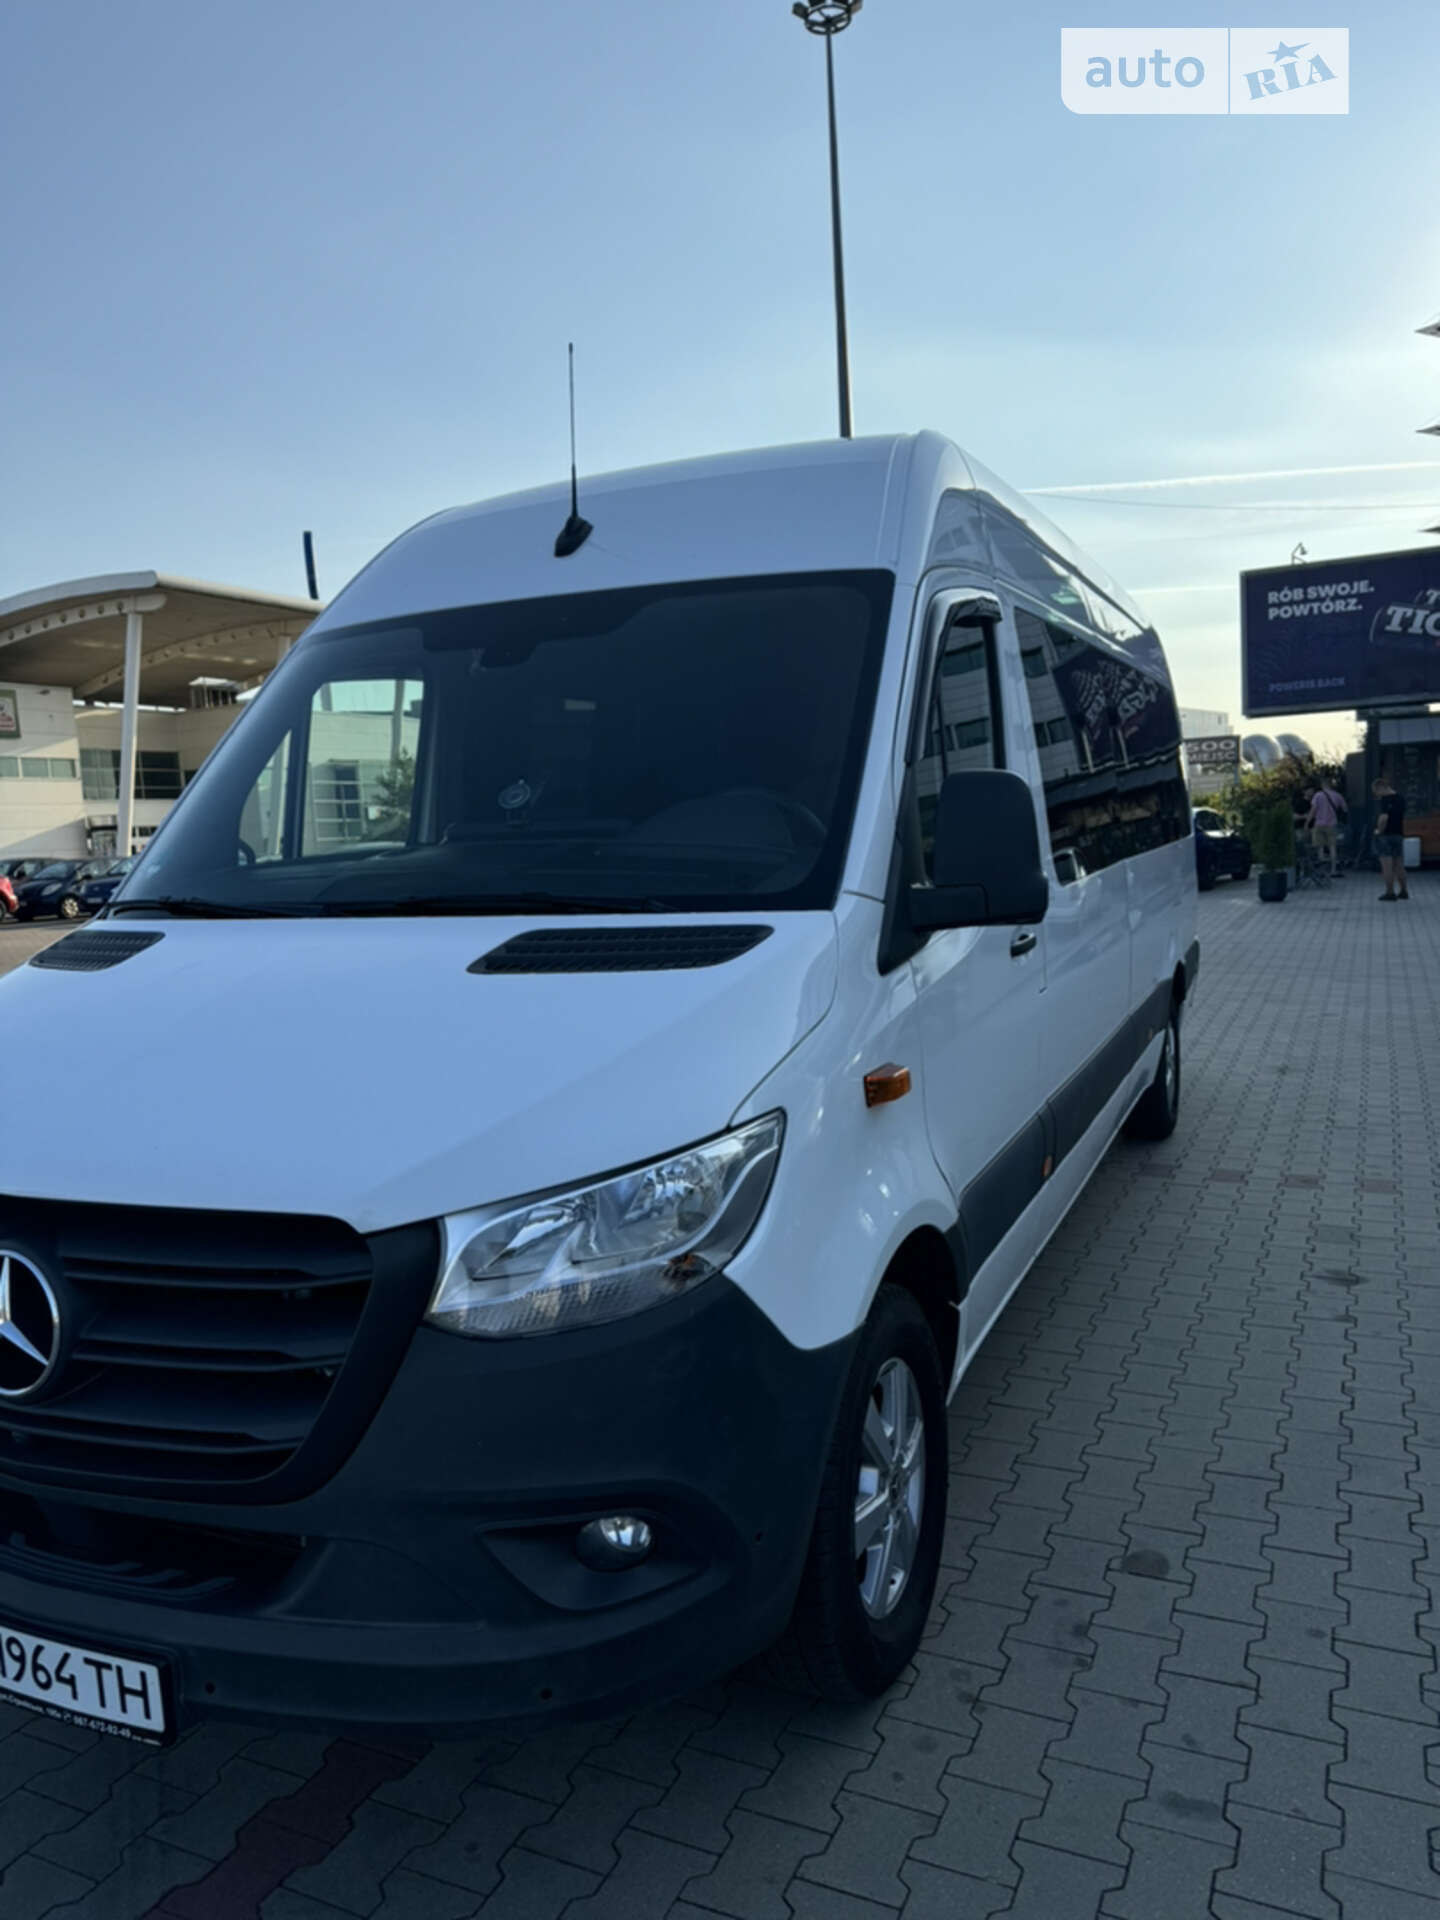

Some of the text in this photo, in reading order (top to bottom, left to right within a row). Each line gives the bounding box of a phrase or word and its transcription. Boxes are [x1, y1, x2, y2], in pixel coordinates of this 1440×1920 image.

[1267, 580, 1375, 604] RÓB SWOJE.
[1268, 599, 1363, 621] POWTÓRZ.
